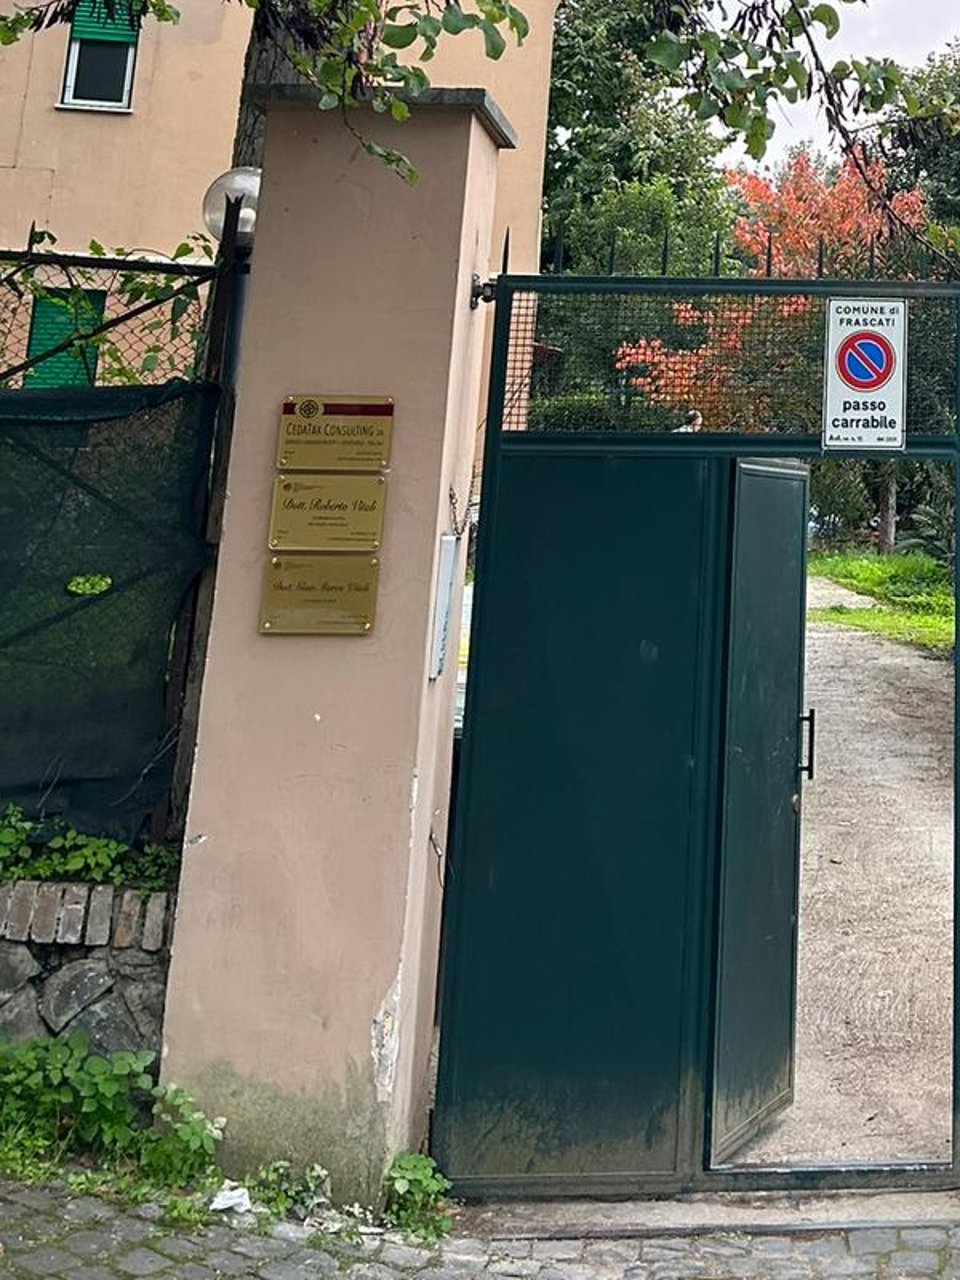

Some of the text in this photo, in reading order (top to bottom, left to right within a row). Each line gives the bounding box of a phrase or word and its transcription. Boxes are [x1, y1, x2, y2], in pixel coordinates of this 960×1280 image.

[835, 306, 886, 315] COMUNE
[839, 318, 896, 327] FRASCATI
[842, 400, 887, 413] passo
[832, 415, 897, 429] carrabile
[309, 498, 348, 512] Roberto
